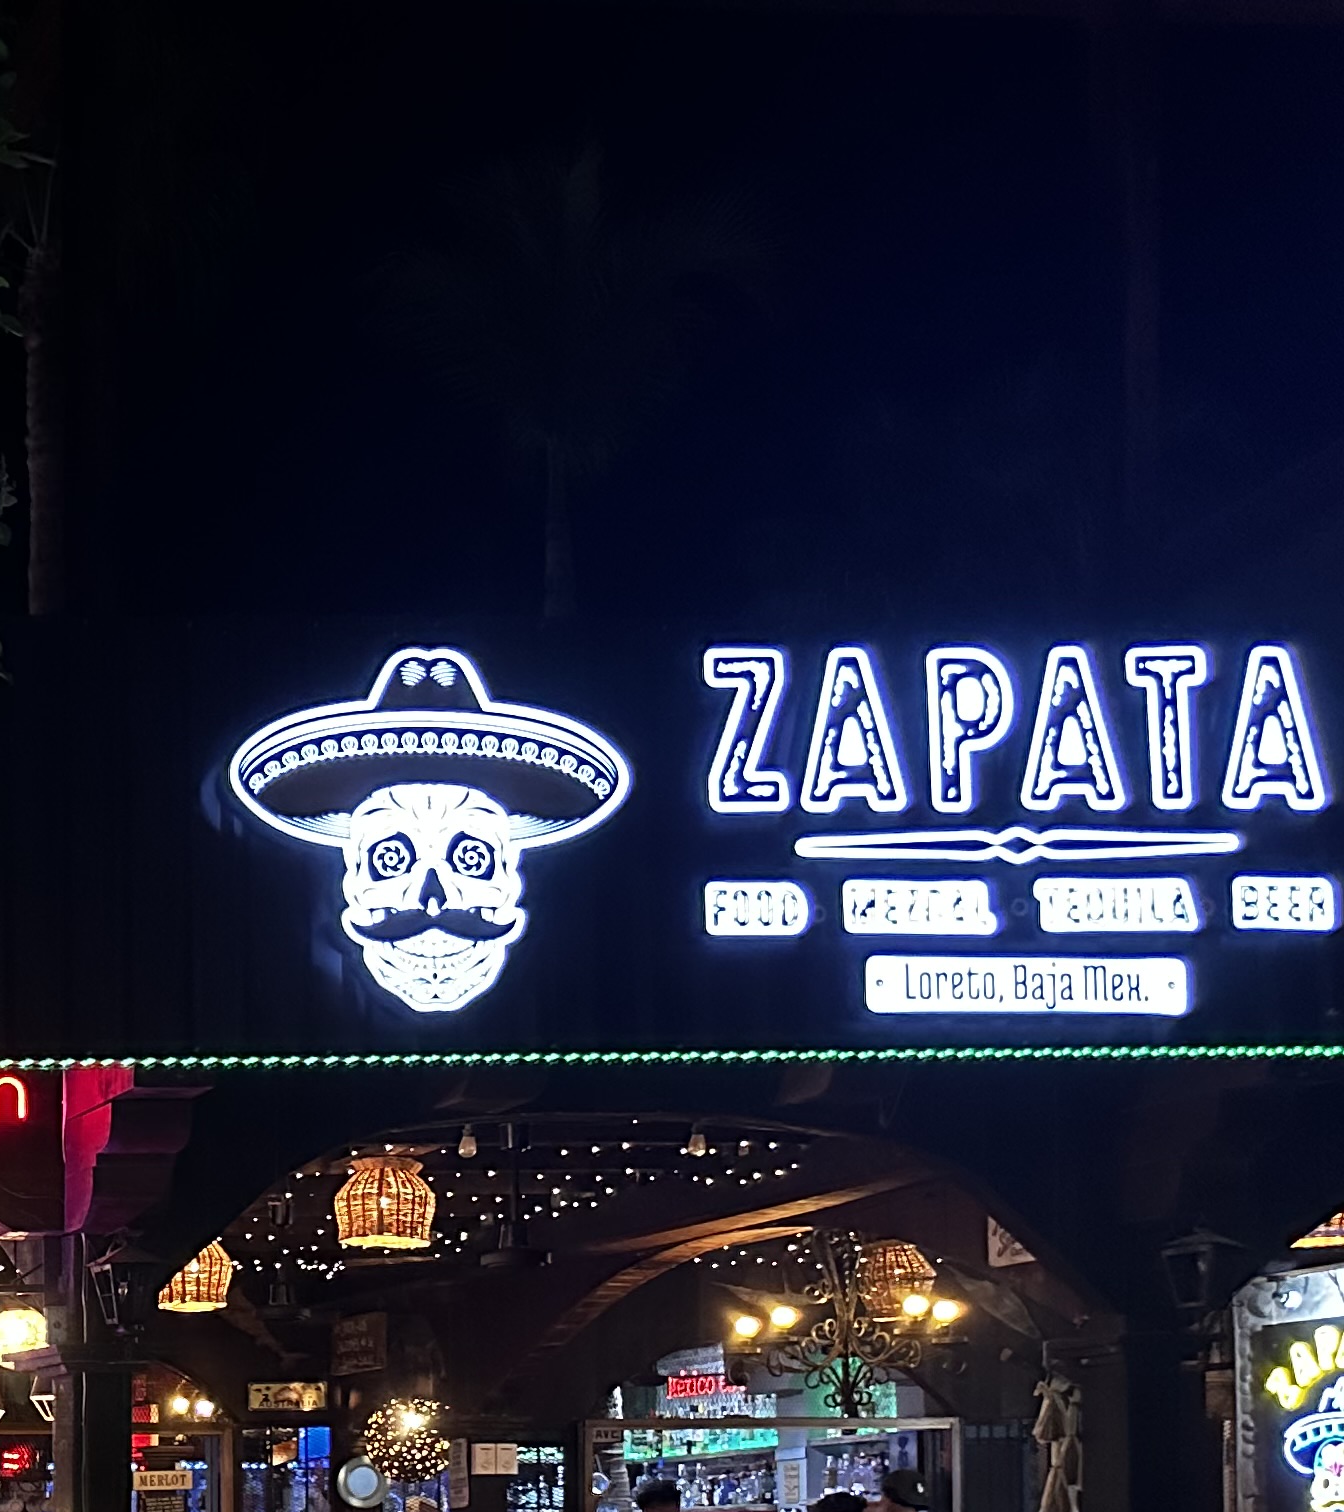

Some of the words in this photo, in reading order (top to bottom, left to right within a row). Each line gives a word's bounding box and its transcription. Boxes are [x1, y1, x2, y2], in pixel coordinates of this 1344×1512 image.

[702, 643, 1324, 812] ZAPATA
[712, 889, 800, 926] FOOD
[1042, 887, 1190, 924] TEQUILA
[1241, 886, 1326, 922] BEER
[904, 963, 1004, 1003] Loreto,
[1012, 963, 1073, 1009] Baja
[1083, 963, 1149, 1002] Mex.
[139, 1472, 188, 1489] MERLOT
